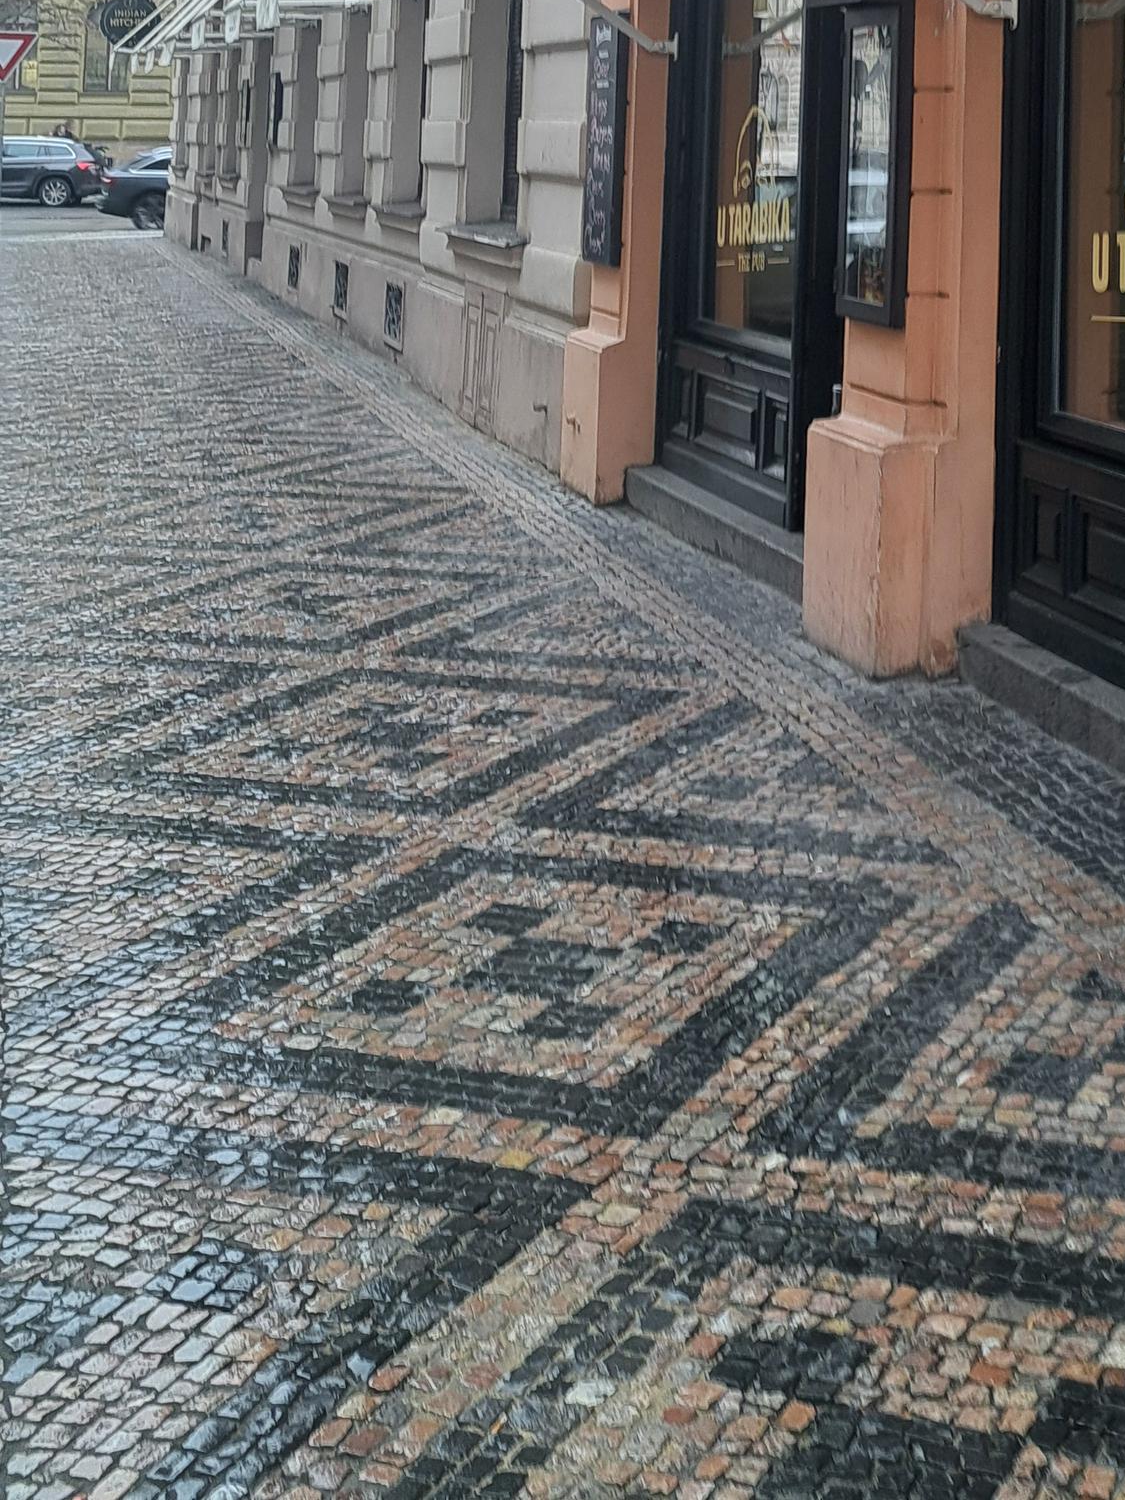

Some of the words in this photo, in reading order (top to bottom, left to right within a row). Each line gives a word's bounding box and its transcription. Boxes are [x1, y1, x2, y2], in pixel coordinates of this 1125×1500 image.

[110, 17, 150, 27] KITCH
[114, 9, 147, 18] INDIAN
[717, 203, 729, 248] U
[1092, 233, 1109, 293] U
